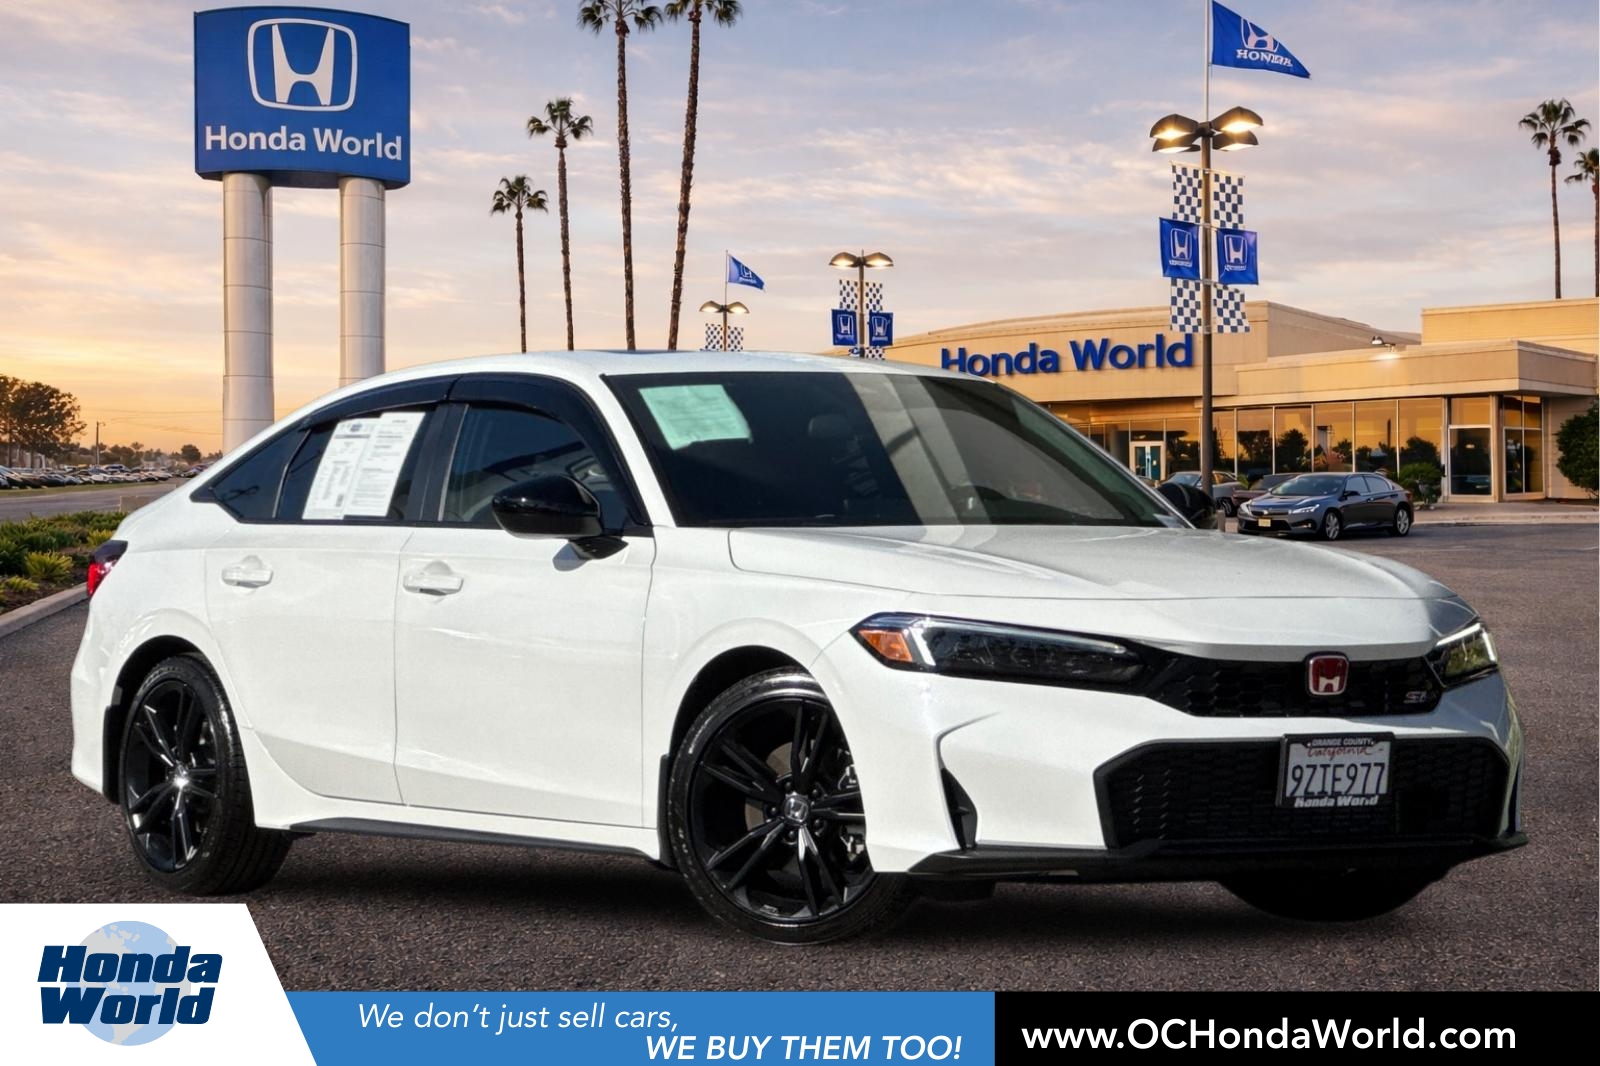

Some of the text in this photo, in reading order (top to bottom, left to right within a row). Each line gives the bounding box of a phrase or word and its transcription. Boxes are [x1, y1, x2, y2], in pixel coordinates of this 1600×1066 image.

[205, 125, 402, 161] Honda World
[941, 333, 1194, 377] Honda World
[1343, 737, 1373, 746] COUNTY
[1290, 763, 1386, 797] 9ZIE977
[1294, 795, 1379, 808] Honda World
